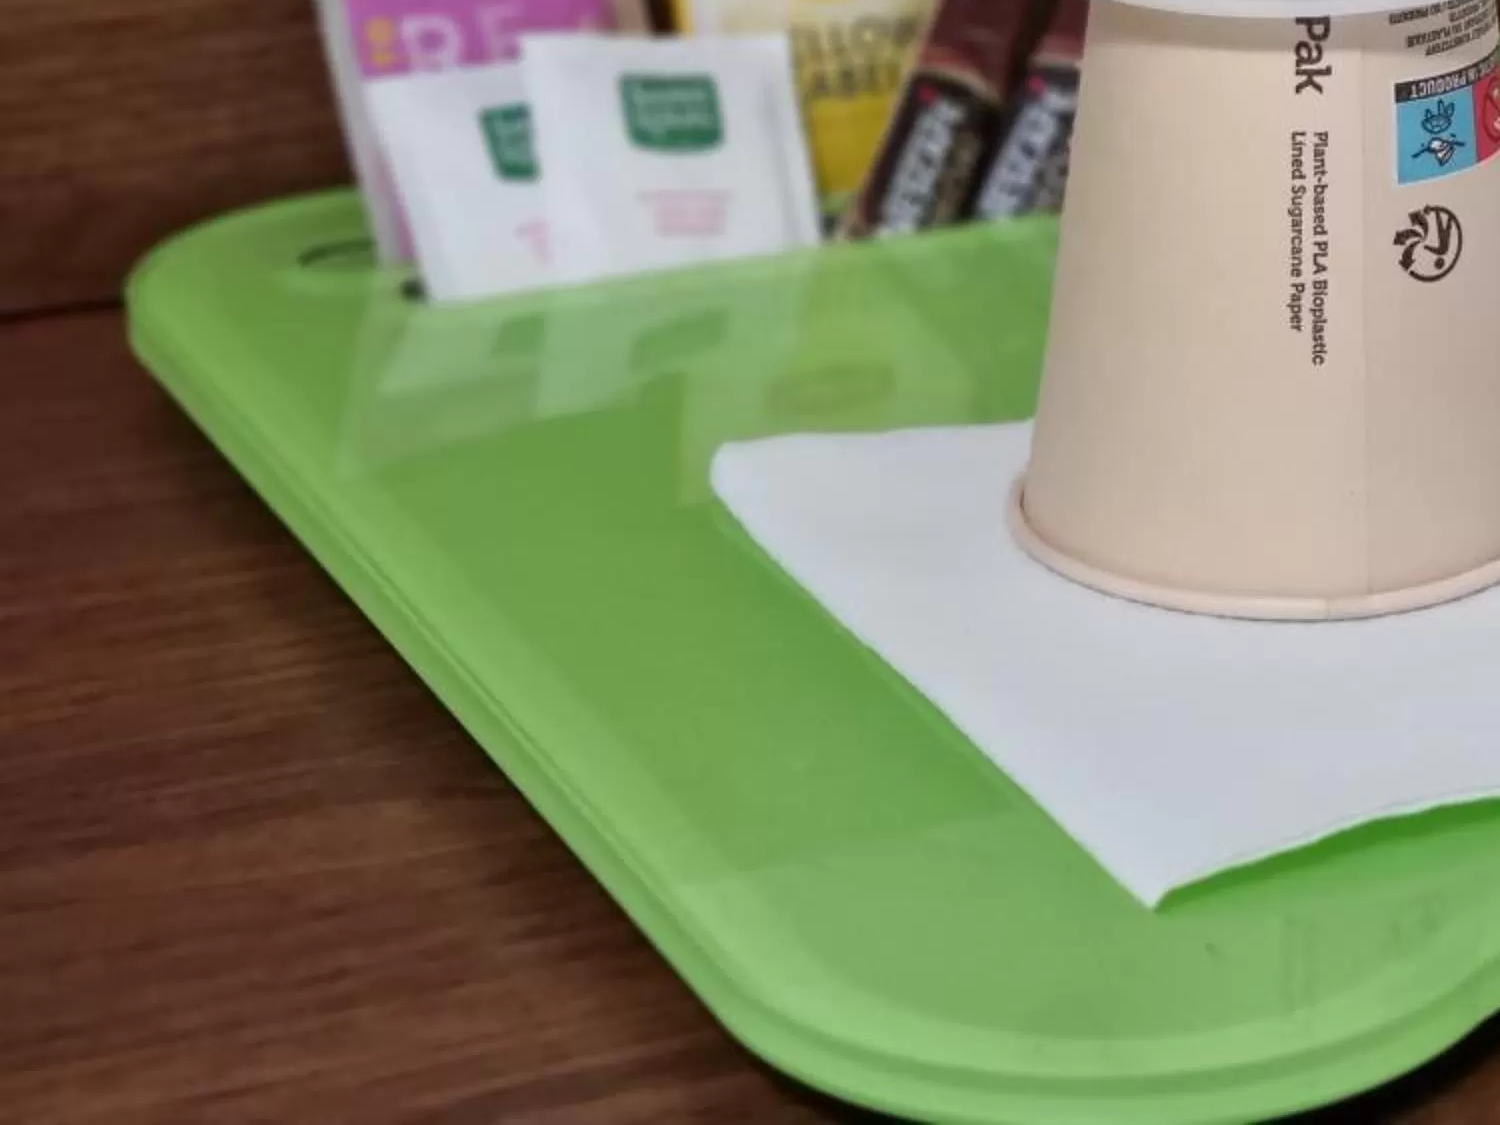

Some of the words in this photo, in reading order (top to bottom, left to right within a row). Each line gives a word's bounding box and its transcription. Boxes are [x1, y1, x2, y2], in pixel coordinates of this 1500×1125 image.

[1294, 15, 1332, 96] Pak
[1408, 69, 1466, 99] PRODUCT
[1290, 130, 1308, 181] Lined
[1313, 130, 1329, 236] Plant-based
[1287, 185, 1306, 278] Sugarcane
[1312, 240, 1328, 275] PLA
[1285, 282, 1305, 333] Paper
[1309, 279, 1328, 366] Bioplastic
